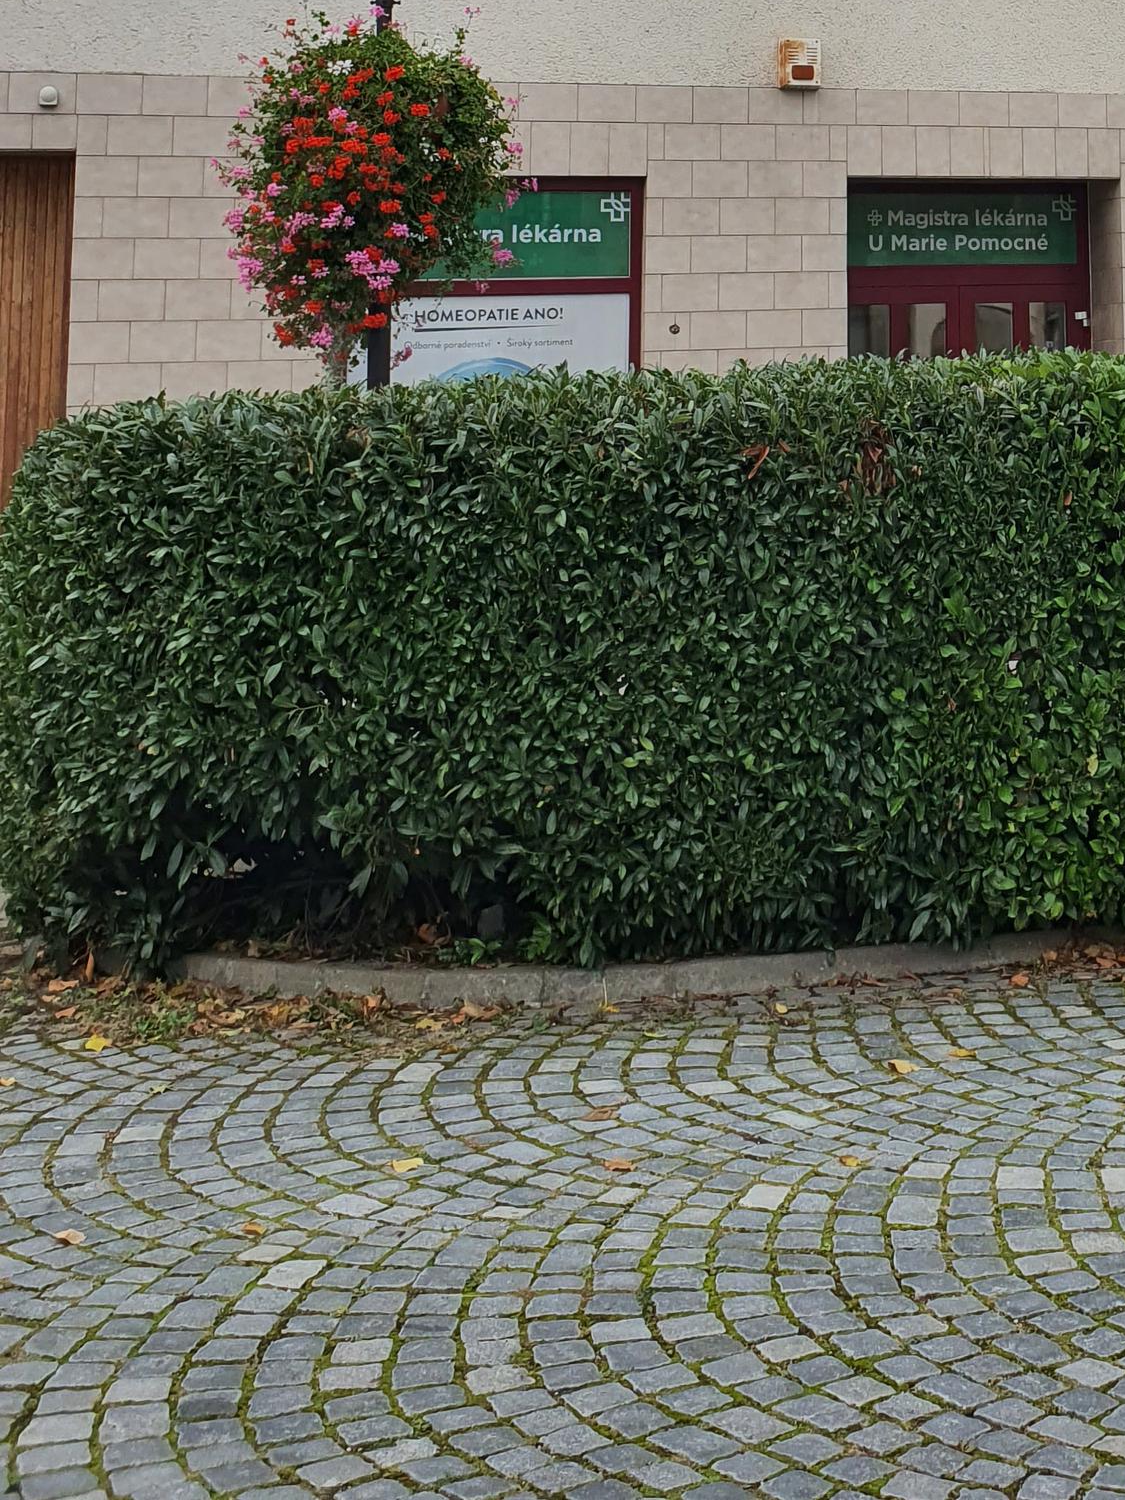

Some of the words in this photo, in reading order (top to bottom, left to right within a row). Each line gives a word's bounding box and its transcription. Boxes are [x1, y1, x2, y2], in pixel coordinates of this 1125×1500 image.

[887, 209, 969, 229] Magistra
[974, 208, 1048, 227] lékárna
[511, 223, 602, 244] lékárna
[868, 235, 884, 251] U
[890, 234, 948, 251] Marie
[954, 233, 1049, 251] Pomocné
[414, 308, 519, 323] HOMEOPATIE
[523, 307, 564, 321] ANO!
[404, 340, 442, 350] Odborné
[443, 339, 492, 351] poradenství
[506, 337, 533, 349] Široký
[534, 338, 574, 348] sortiment
